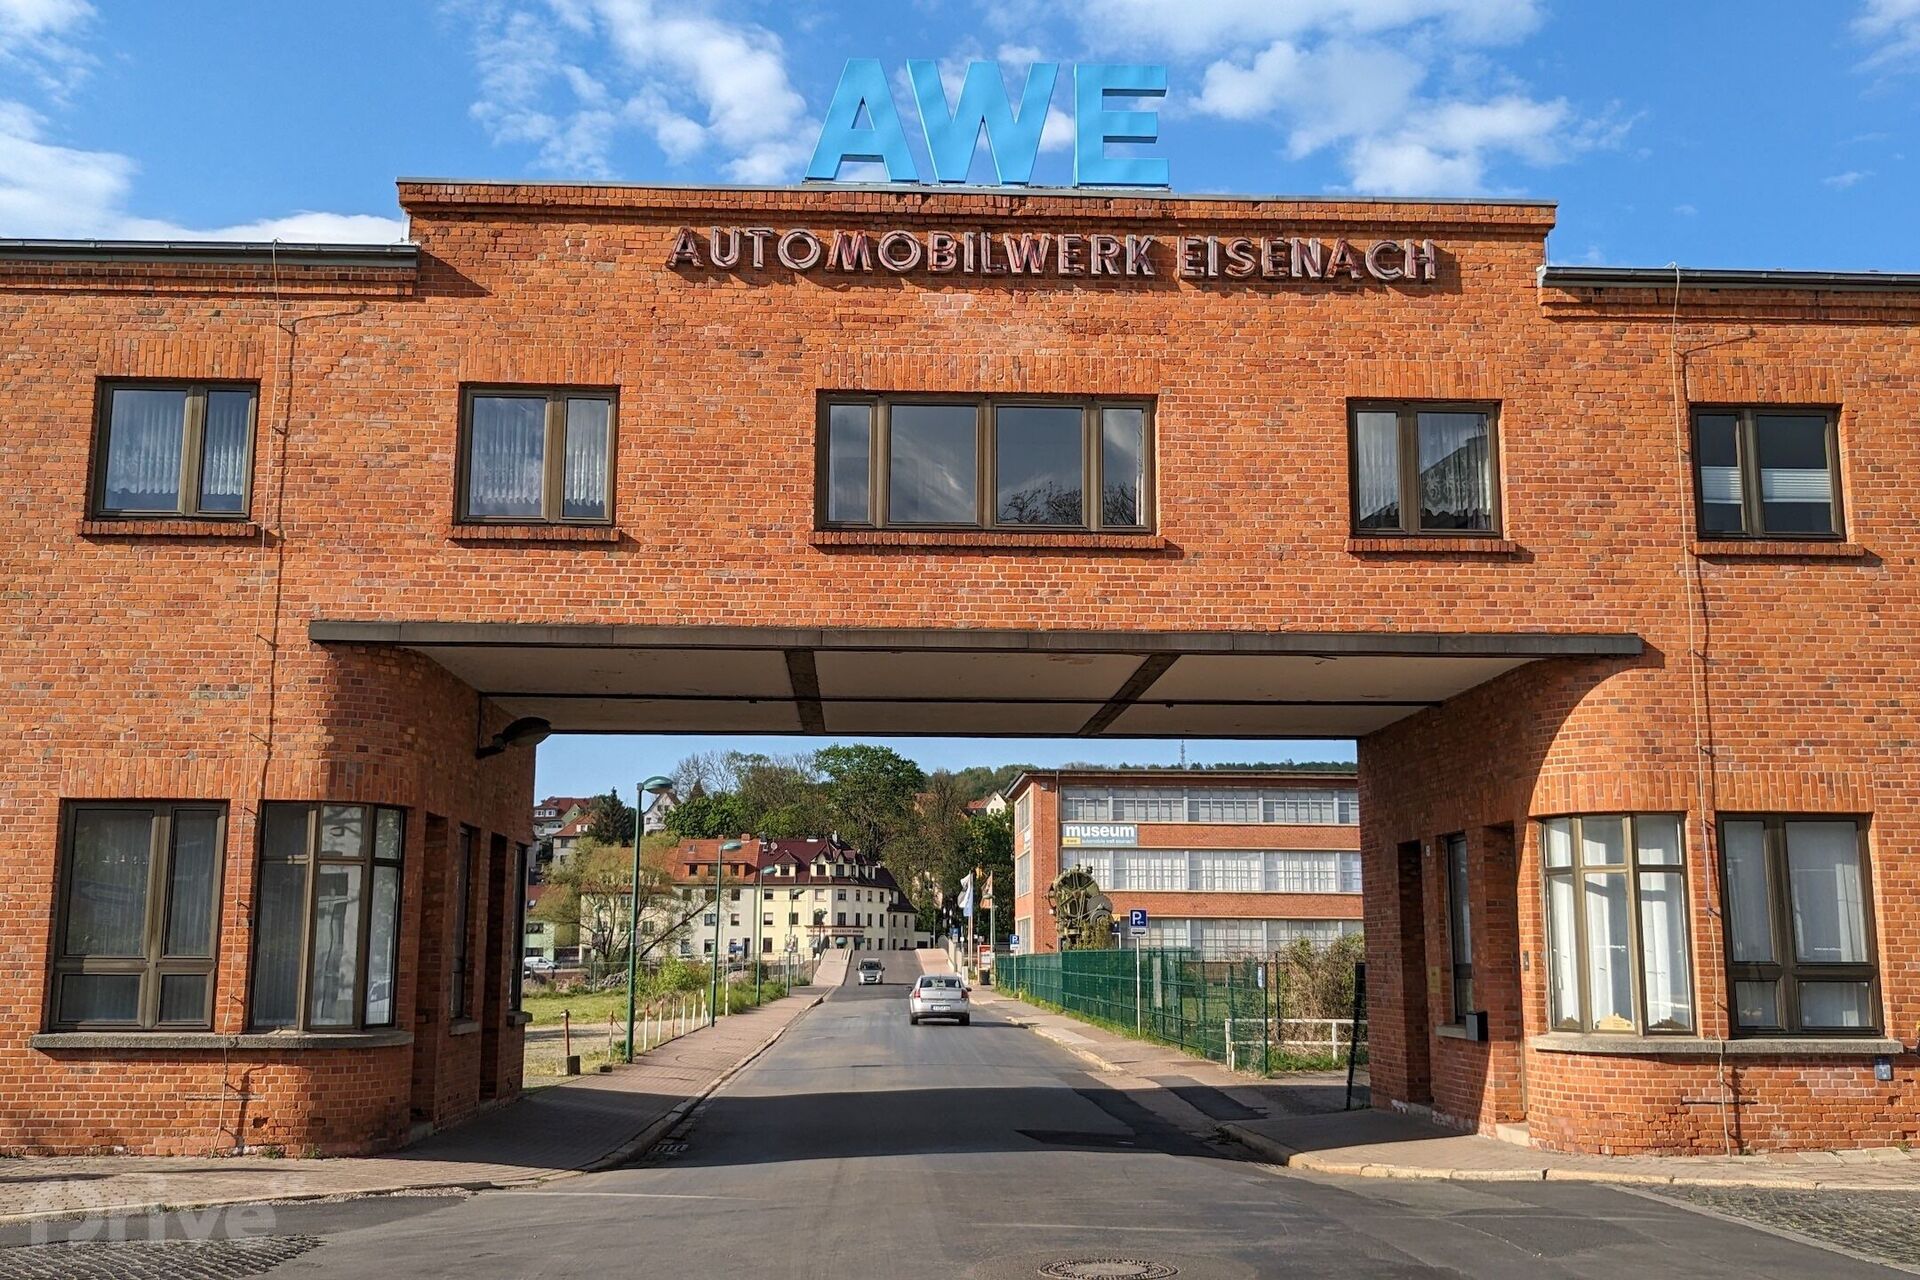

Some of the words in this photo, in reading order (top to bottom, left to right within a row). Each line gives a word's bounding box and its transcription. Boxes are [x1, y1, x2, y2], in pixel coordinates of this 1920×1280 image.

[802, 58, 1170, 187] AWE
[666, 226, 1154, 277] AUTOMOBILWERK
[1176, 236, 1436, 281] EISENACH
[1066, 825, 1135, 837] museum
[1132, 911, 1142, 925] P
